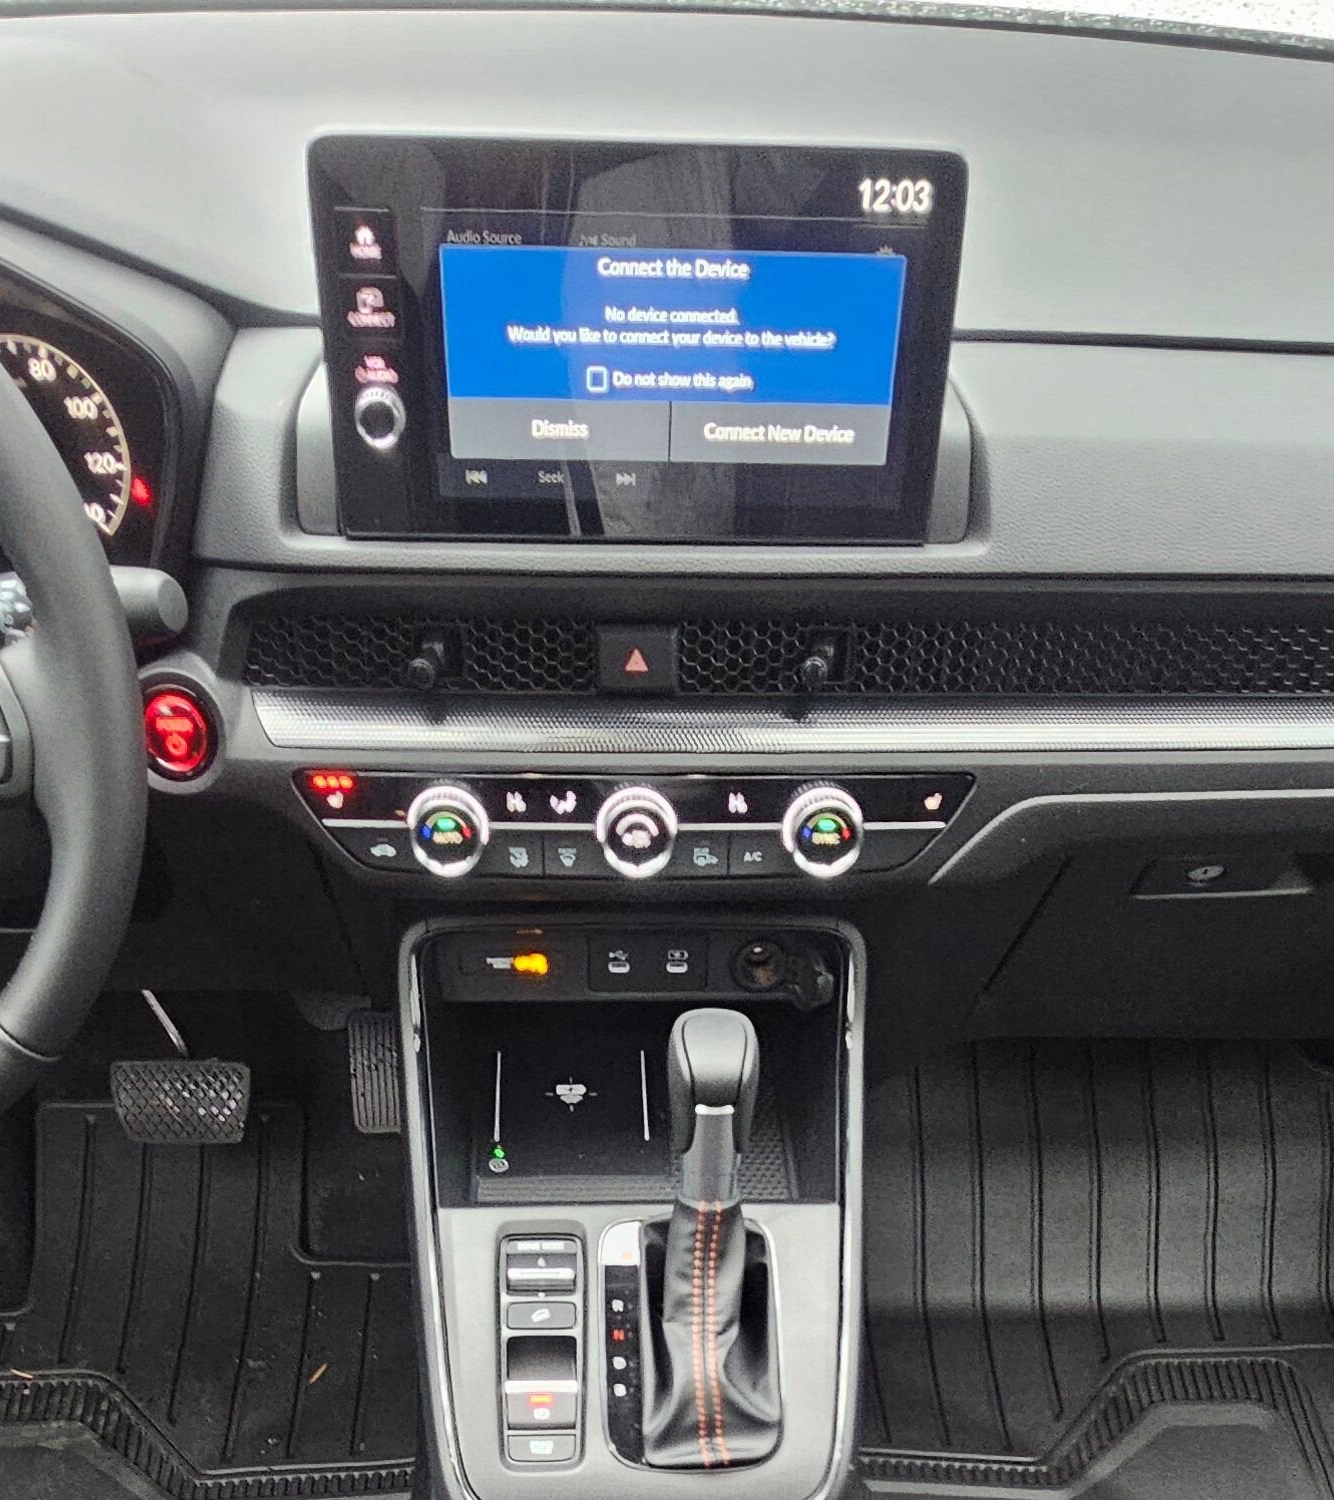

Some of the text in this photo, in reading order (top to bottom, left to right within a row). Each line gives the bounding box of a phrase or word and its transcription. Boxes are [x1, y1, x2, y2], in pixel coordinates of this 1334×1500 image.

[859, 178, 933, 213] 12:03
[447, 229, 522, 245] Audio Source
[601, 233, 636, 246] Sound
[598, 258, 751, 280] Connect the Device
[605, 306, 625, 323] No
[627, 306, 667, 322] device
[507, 325, 837, 350] Would you like to connect your device to the vehicle?
[27, 357, 57, 382] 80
[613, 371, 632, 387] Do
[634, 371, 656, 387] not
[658, 371, 692, 388] show
[693, 372, 716, 388] this
[63, 396, 98, 420] 100
[531, 419, 590, 440] Dismiss
[703, 422, 855, 444] Connect New Device
[84, 451, 117, 475] 120
[538, 470, 564, 484] Seek
[743, 851, 763, 862] A/C
[613, 1328, 625, 1341] N
